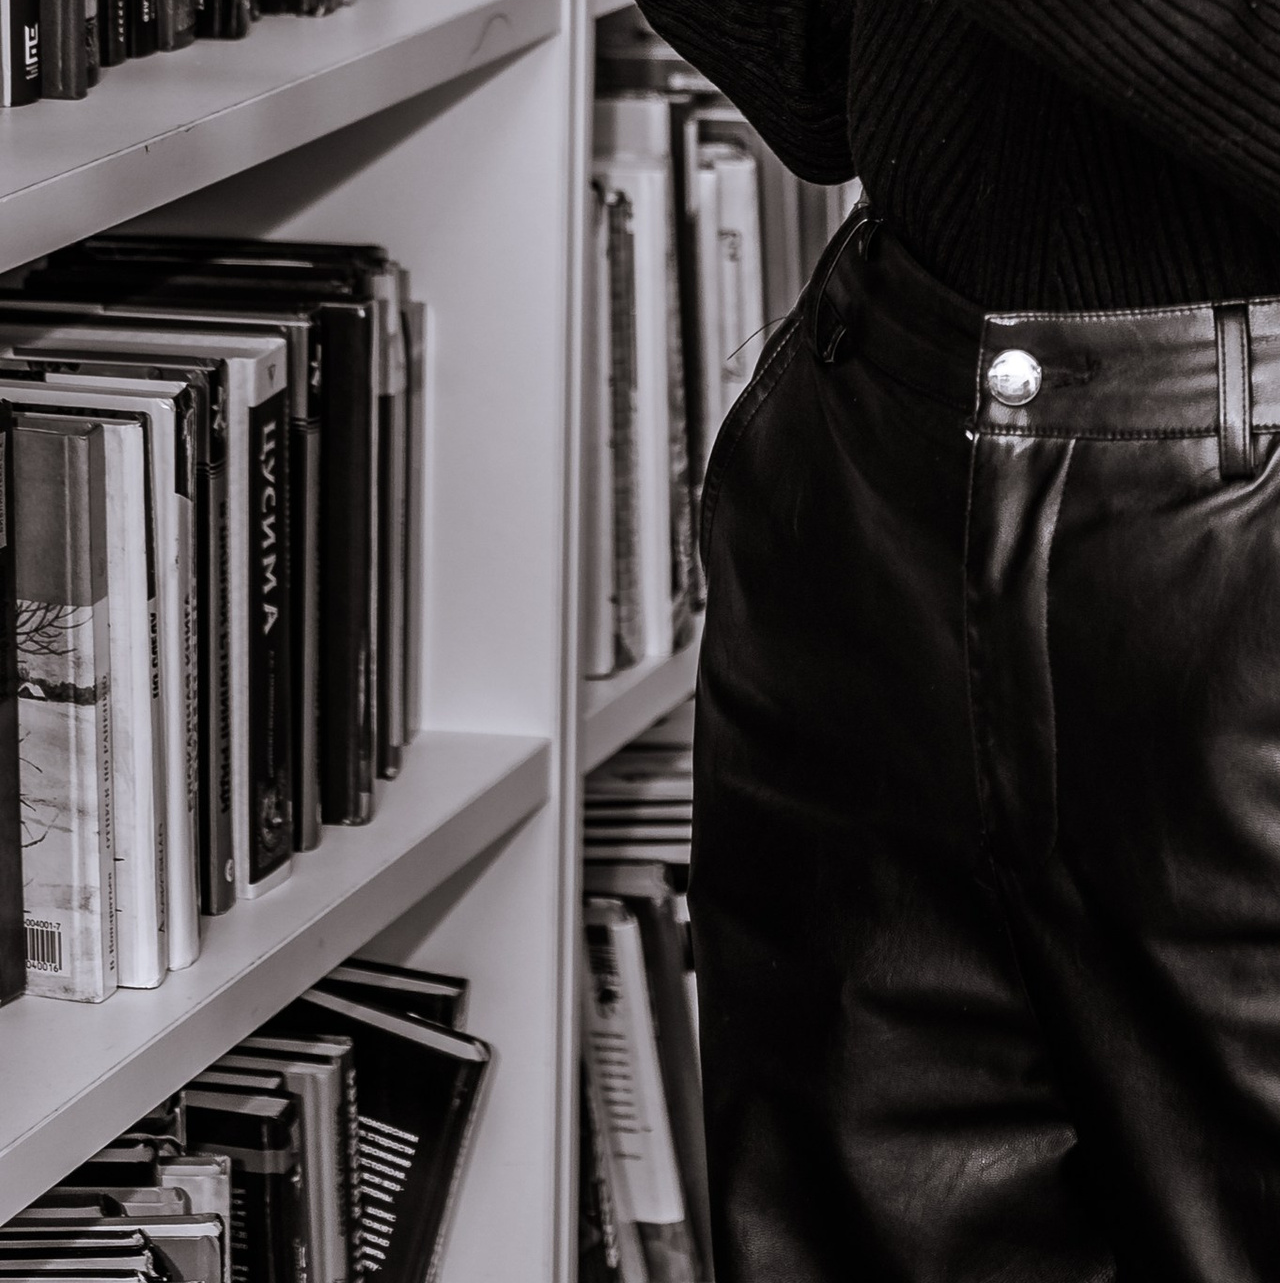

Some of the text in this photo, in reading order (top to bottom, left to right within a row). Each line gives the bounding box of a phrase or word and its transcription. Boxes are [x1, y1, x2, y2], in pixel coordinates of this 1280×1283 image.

[258, 421, 280, 636] ЦУСИМА
[101, 674, 110, 754] РАНЕНИЮ
[103, 788, 111, 850] ОТПУСК
